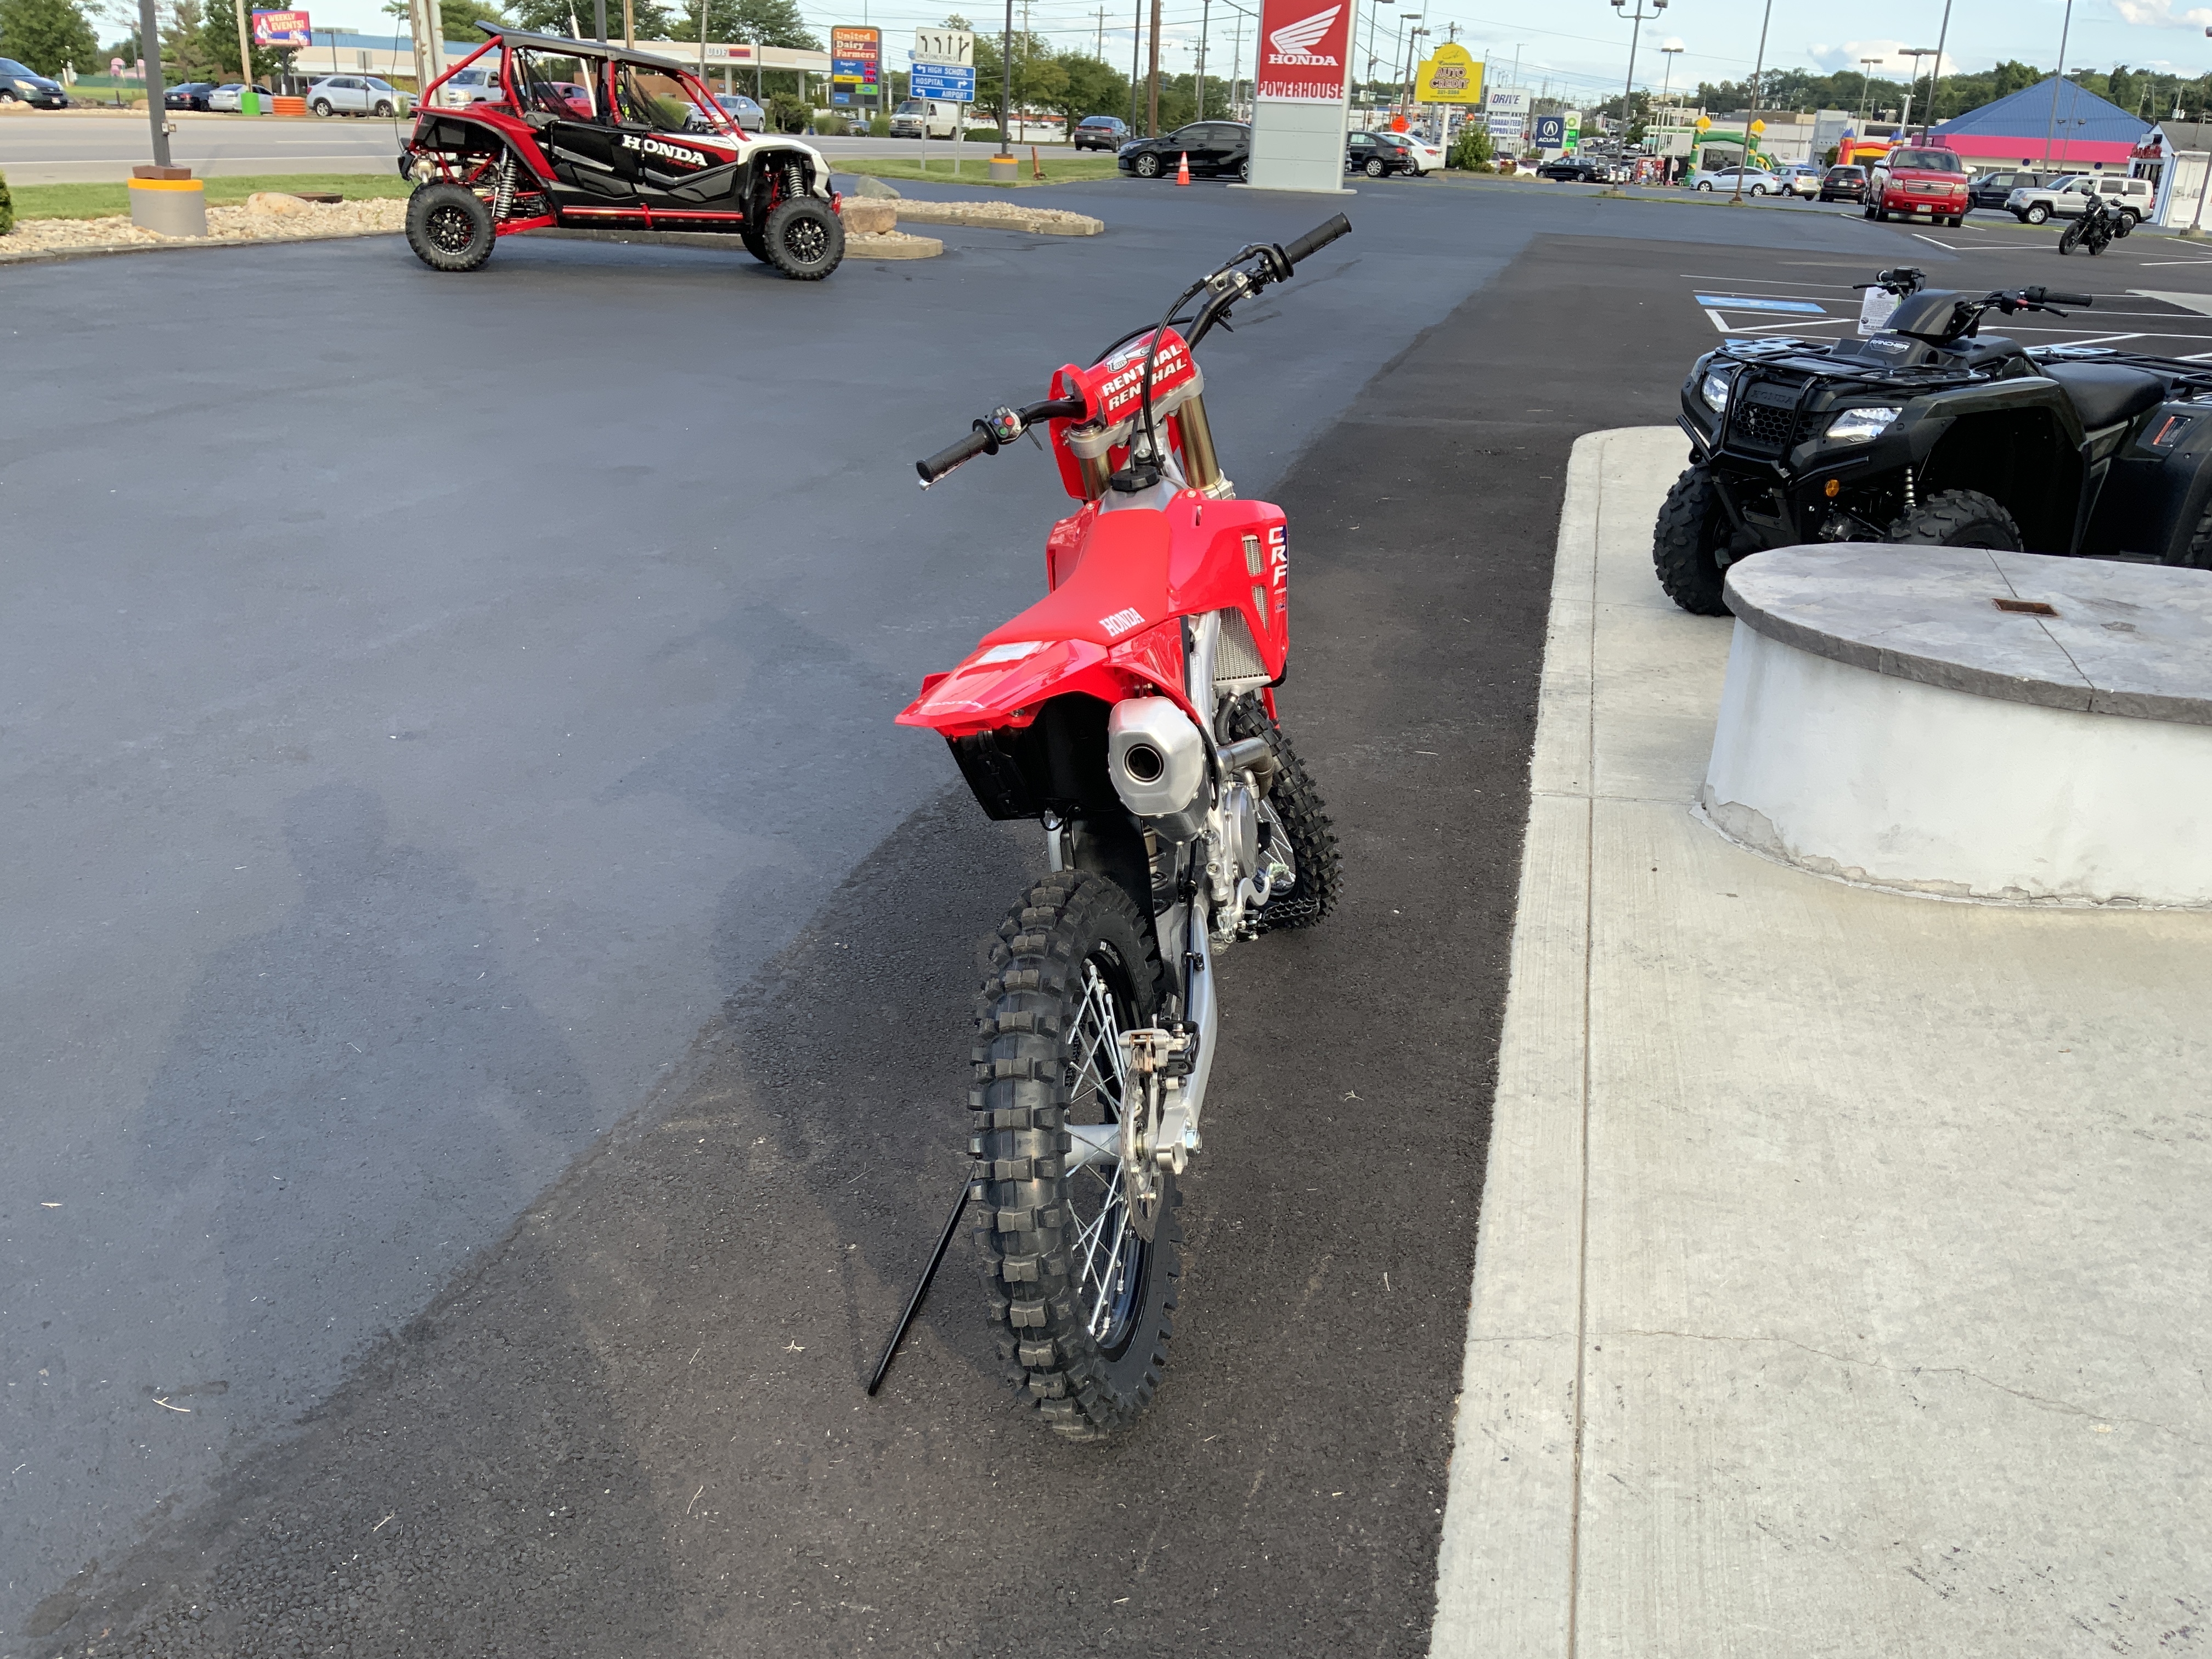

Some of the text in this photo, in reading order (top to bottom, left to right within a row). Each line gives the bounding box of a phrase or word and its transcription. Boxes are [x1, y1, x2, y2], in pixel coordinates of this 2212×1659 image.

[267, 13, 295, 22] WEEKLY
[271, 20, 304, 31] EVENTS!
[836, 31, 871, 40] United
[836, 41, 865, 50] Dairy
[707, 48, 727, 56] UDF
[836, 49, 876, 58] Farmers
[1268, 54, 1339, 66] HONDA
[944, 67, 968, 76] SCHOOL
[1435, 67, 1466, 78] AUTO
[915, 77, 944, 86] HOSPITAL
[1430, 78, 1470, 89] CREDIT
[941, 91, 967, 99] AIRPORT
[1258, 81, 1344, 99] POWERHOUSE
[1489, 93, 1521, 104] iDRIVE
[622, 135, 708, 166] HONDA
[1870, 340, 1910, 350] RANCHER
[1109, 358, 1187, 411] RENHAL
[1268, 526, 1288, 587] CRF
[1098, 607, 1146, 637] HONDA
